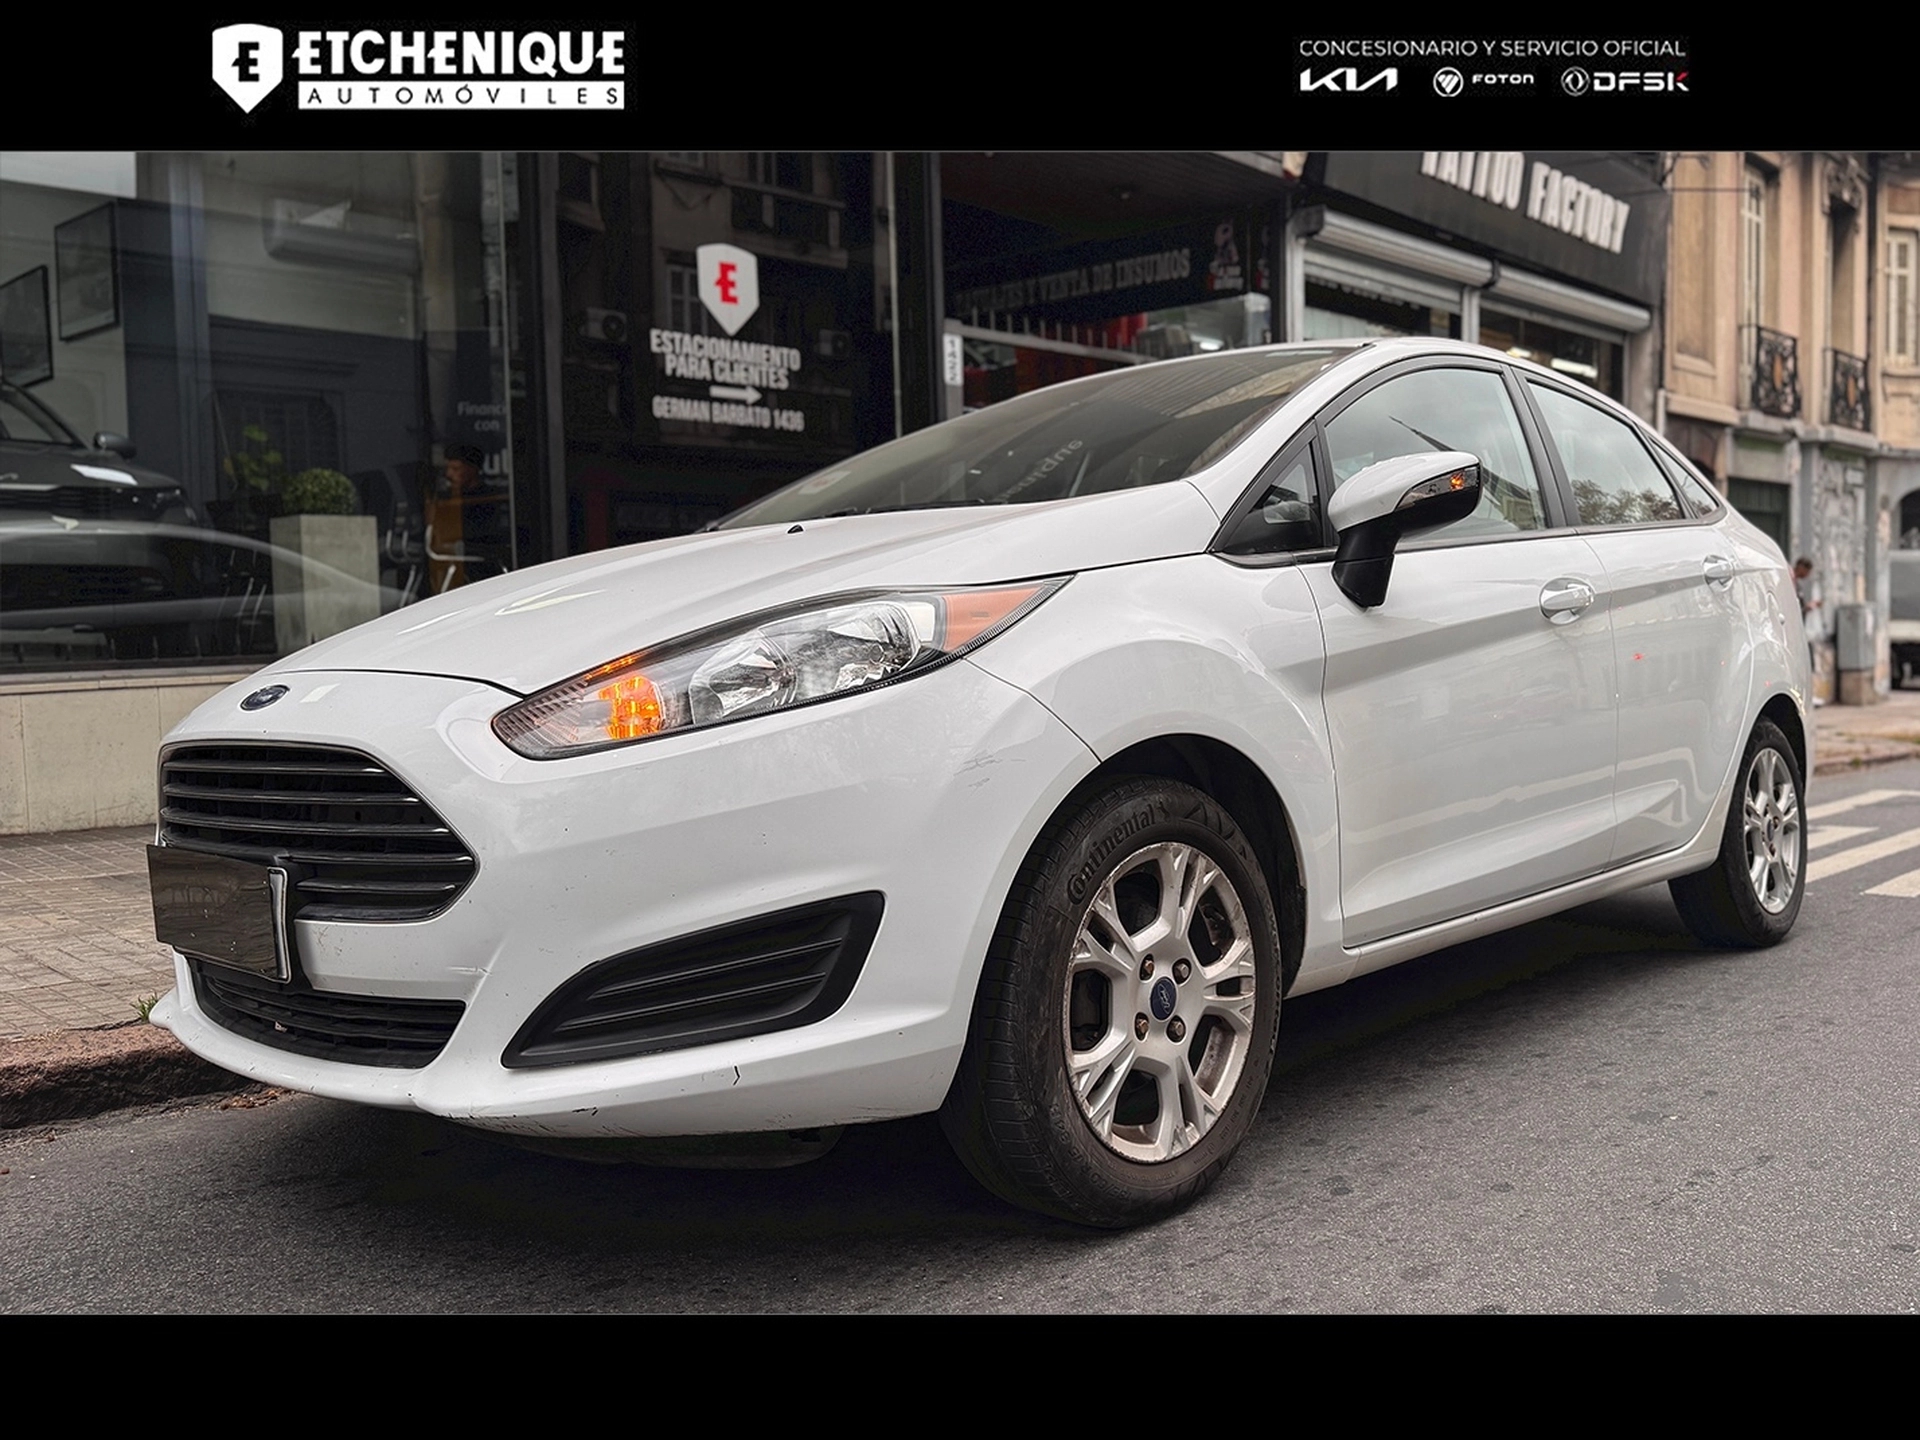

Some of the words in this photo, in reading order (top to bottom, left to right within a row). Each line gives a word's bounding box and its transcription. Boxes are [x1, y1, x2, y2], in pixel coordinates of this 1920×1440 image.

[1526, 161, 1631, 254] FACTORY
[1092, 262, 1114, 292] DE
[1115, 248, 1191, 289] INSUMOS
[650, 328, 801, 371] ESTACIONAMIENTO
[665, 354, 712, 381] PARA
[713, 360, 789, 390] CLIENTES
[652, 395, 710, 422] GERMAN
[1067, 803, 1156, 905] Continental
